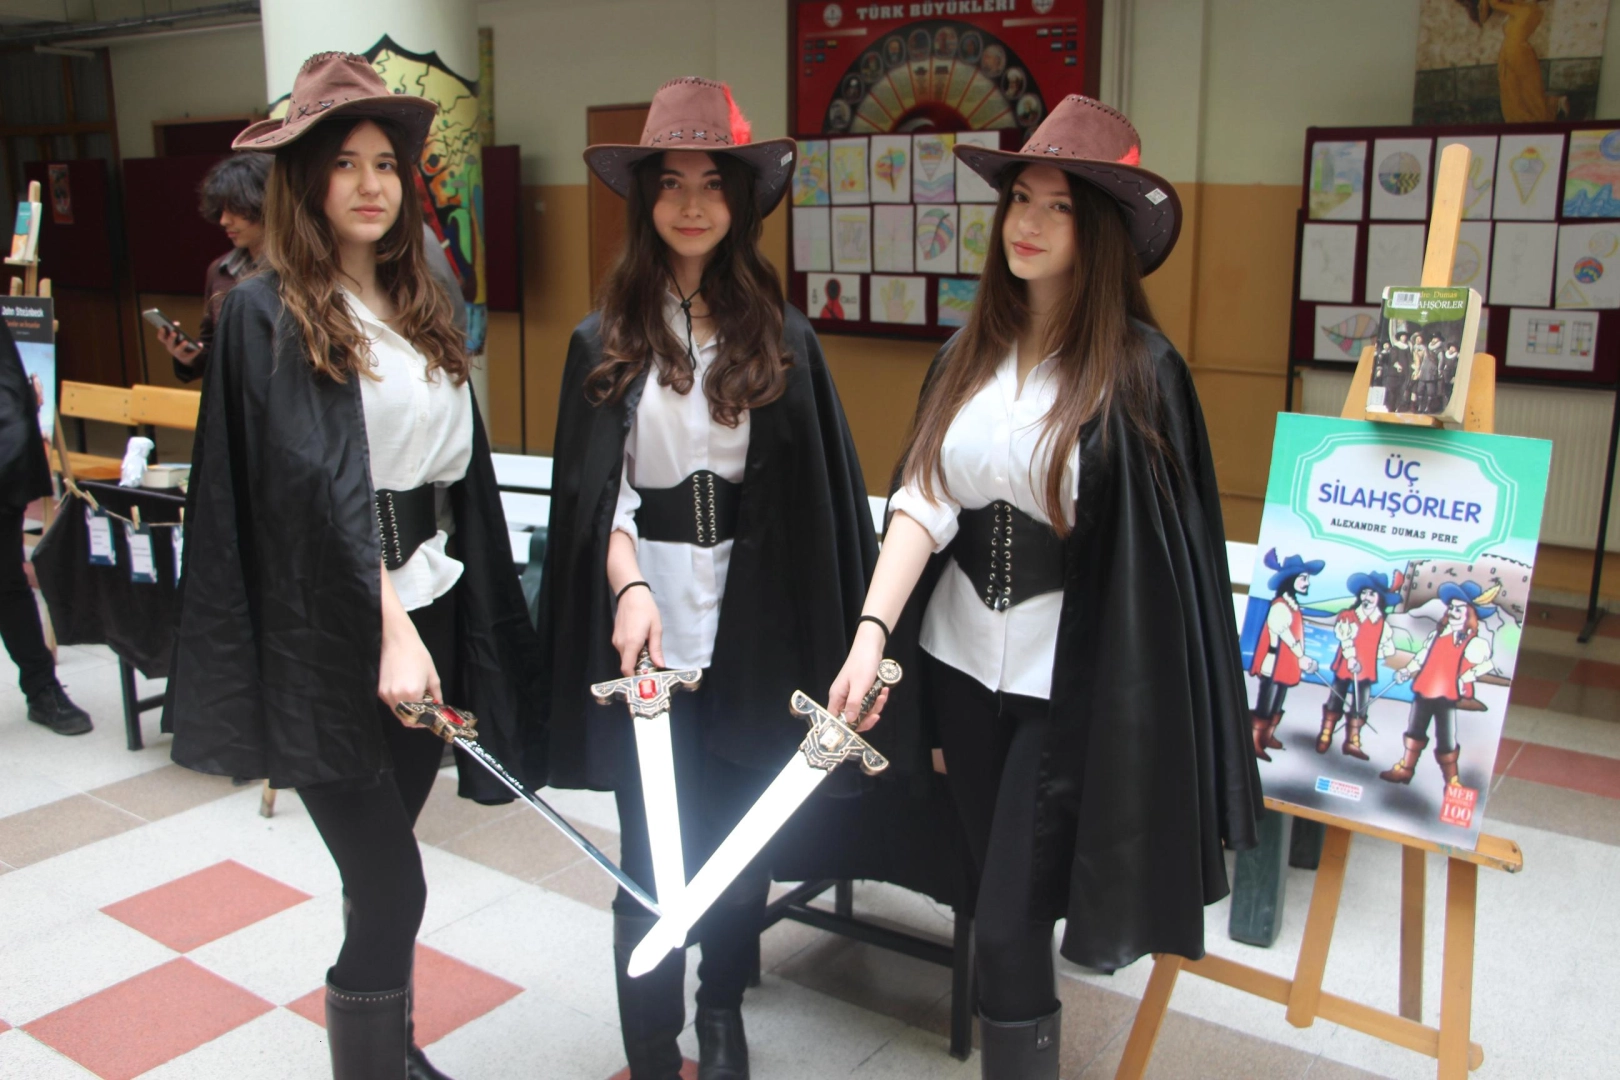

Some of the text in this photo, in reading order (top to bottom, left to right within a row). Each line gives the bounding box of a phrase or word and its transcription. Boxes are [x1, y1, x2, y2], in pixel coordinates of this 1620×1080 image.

[856, 4, 905, 20] TÜRK
[1384, 453, 1421, 487] ÜÇ
[1318, 479, 1482, 524] SİLAHŞÖRLER
[1330, 518, 1459, 544] ALEXANDRE DUMAS PERE
[1443, 803, 1472, 821] 100
